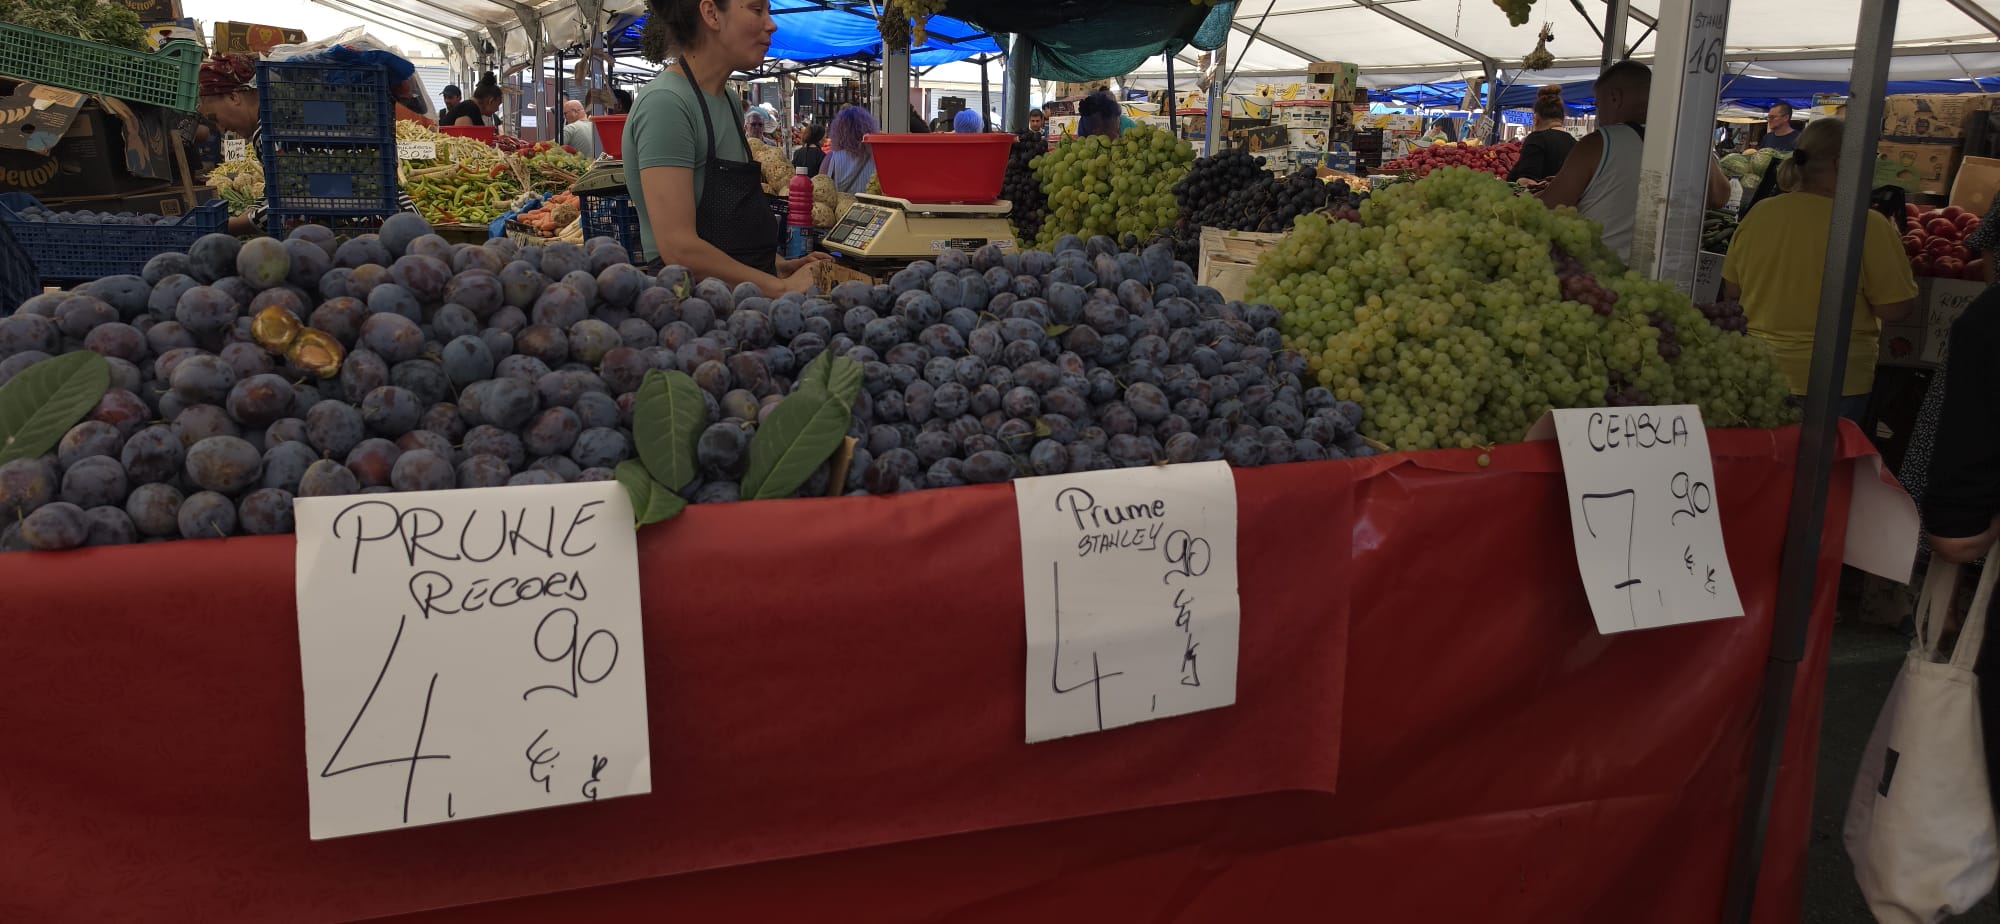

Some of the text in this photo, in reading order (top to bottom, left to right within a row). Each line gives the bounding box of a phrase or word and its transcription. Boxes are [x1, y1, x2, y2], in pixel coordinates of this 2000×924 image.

[1688, 37, 1722, 74] 16
[1670, 471, 1711, 526] 90
[332, 500, 606, 574] PRUNE
[1078, 521, 1164, 557] STANLEY
[1163, 529, 1211, 585] 90
[522, 607, 619, 701] 90
